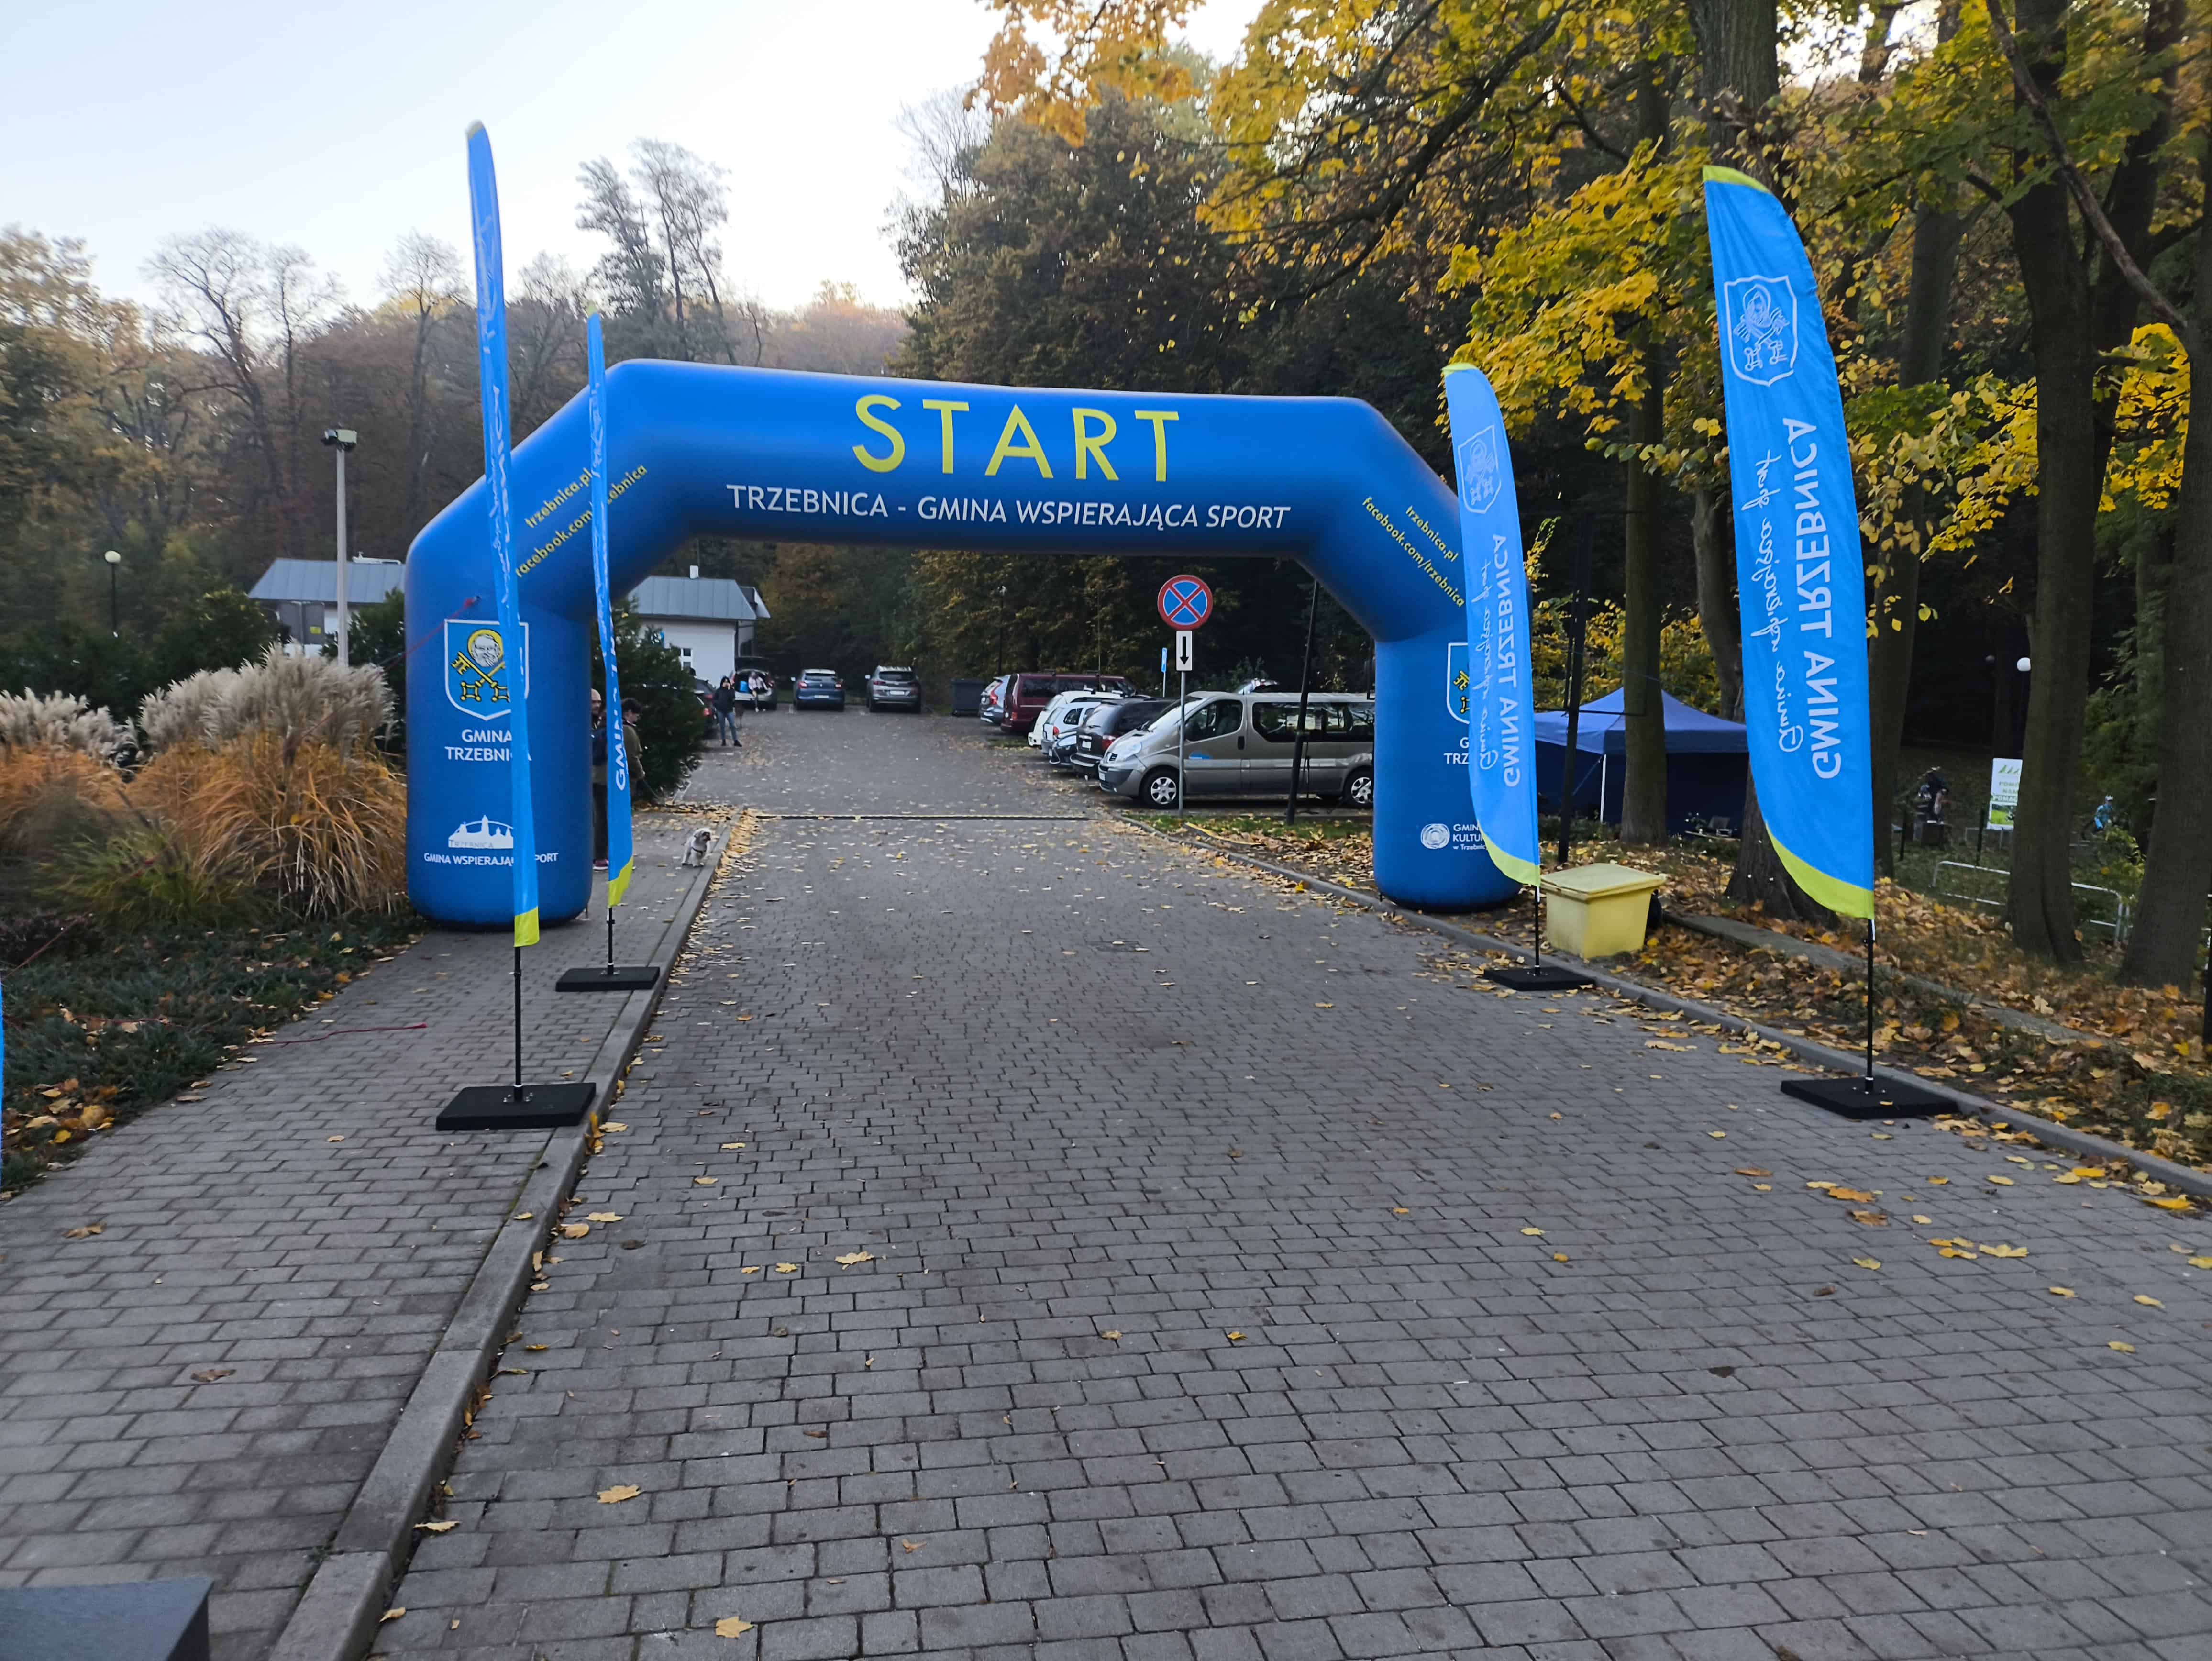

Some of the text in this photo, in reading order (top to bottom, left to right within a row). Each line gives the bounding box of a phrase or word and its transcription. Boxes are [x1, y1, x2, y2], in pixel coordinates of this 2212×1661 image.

[852, 394, 1179, 482] START
[524, 467, 593, 528] trzebnica.pl
[726, 484, 888, 517] TRZEBNICA
[918, 496, 1006, 522] GMINA
[1016, 500, 1198, 531] WSPIERAJĄCA
[1206, 505, 1291, 529] SPORT
[1405, 505, 1459, 562] trzebnica.pl
[1362, 496, 1465, 607] facebook.com/trzebnica
[462, 729, 512, 742] GMINA
[444, 746, 532, 761] TRZEBNI
[1453, 823, 1479, 831] GMIN
[1453, 834, 1483, 842] KULTU
[424, 852, 559, 866] GMINA WSPIERAJĄ PORT
